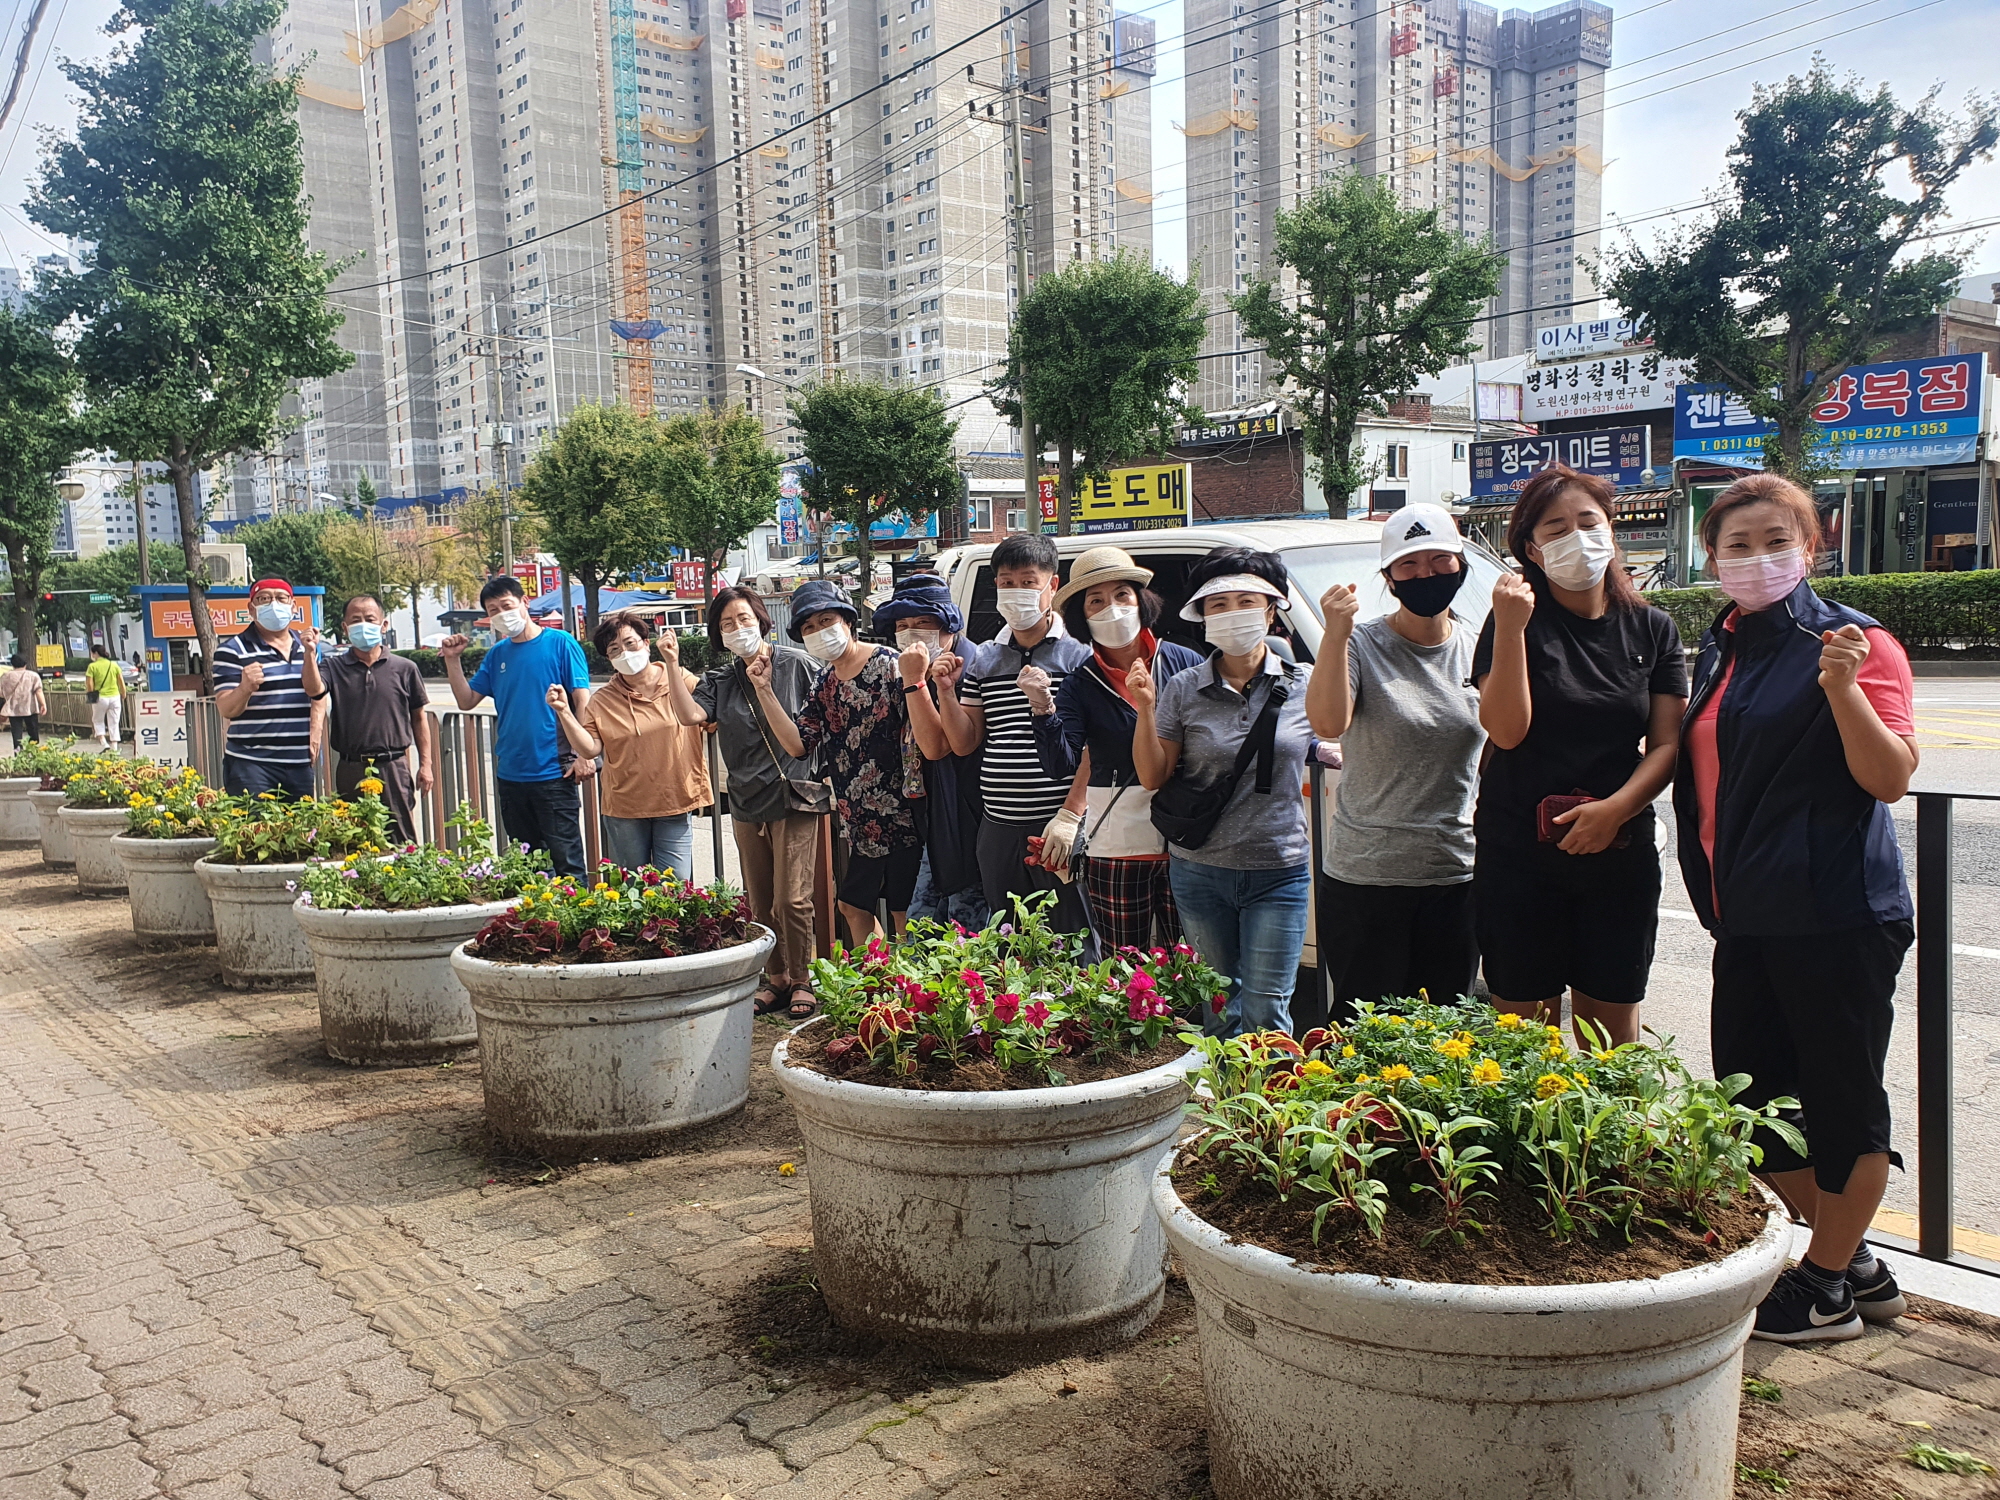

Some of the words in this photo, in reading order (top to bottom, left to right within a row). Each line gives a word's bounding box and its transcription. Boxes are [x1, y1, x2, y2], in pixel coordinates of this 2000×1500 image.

[1128, 36, 1144, 48] 110
[1541, 319, 1638, 346] 이사벨의
[1536, 385, 1650, 408] 도원신생아작명연구원
[1686, 387, 1784, 429] 젠틀
[1809, 361, 1970, 423] 양복점
[1619, 433, 1639, 444] A/S
[1713, 437, 1742, 450] 031)
[1745, 436, 1765, 448] 49
[1831, 422, 1948, 442] 010-8278-1353
[1501, 440, 1560, 474] 정수기
[1569, 435, 1612, 469] 마트
[1933, 501, 1977, 509] Gentlem
[1615, 533, 1629, 541] 수기
